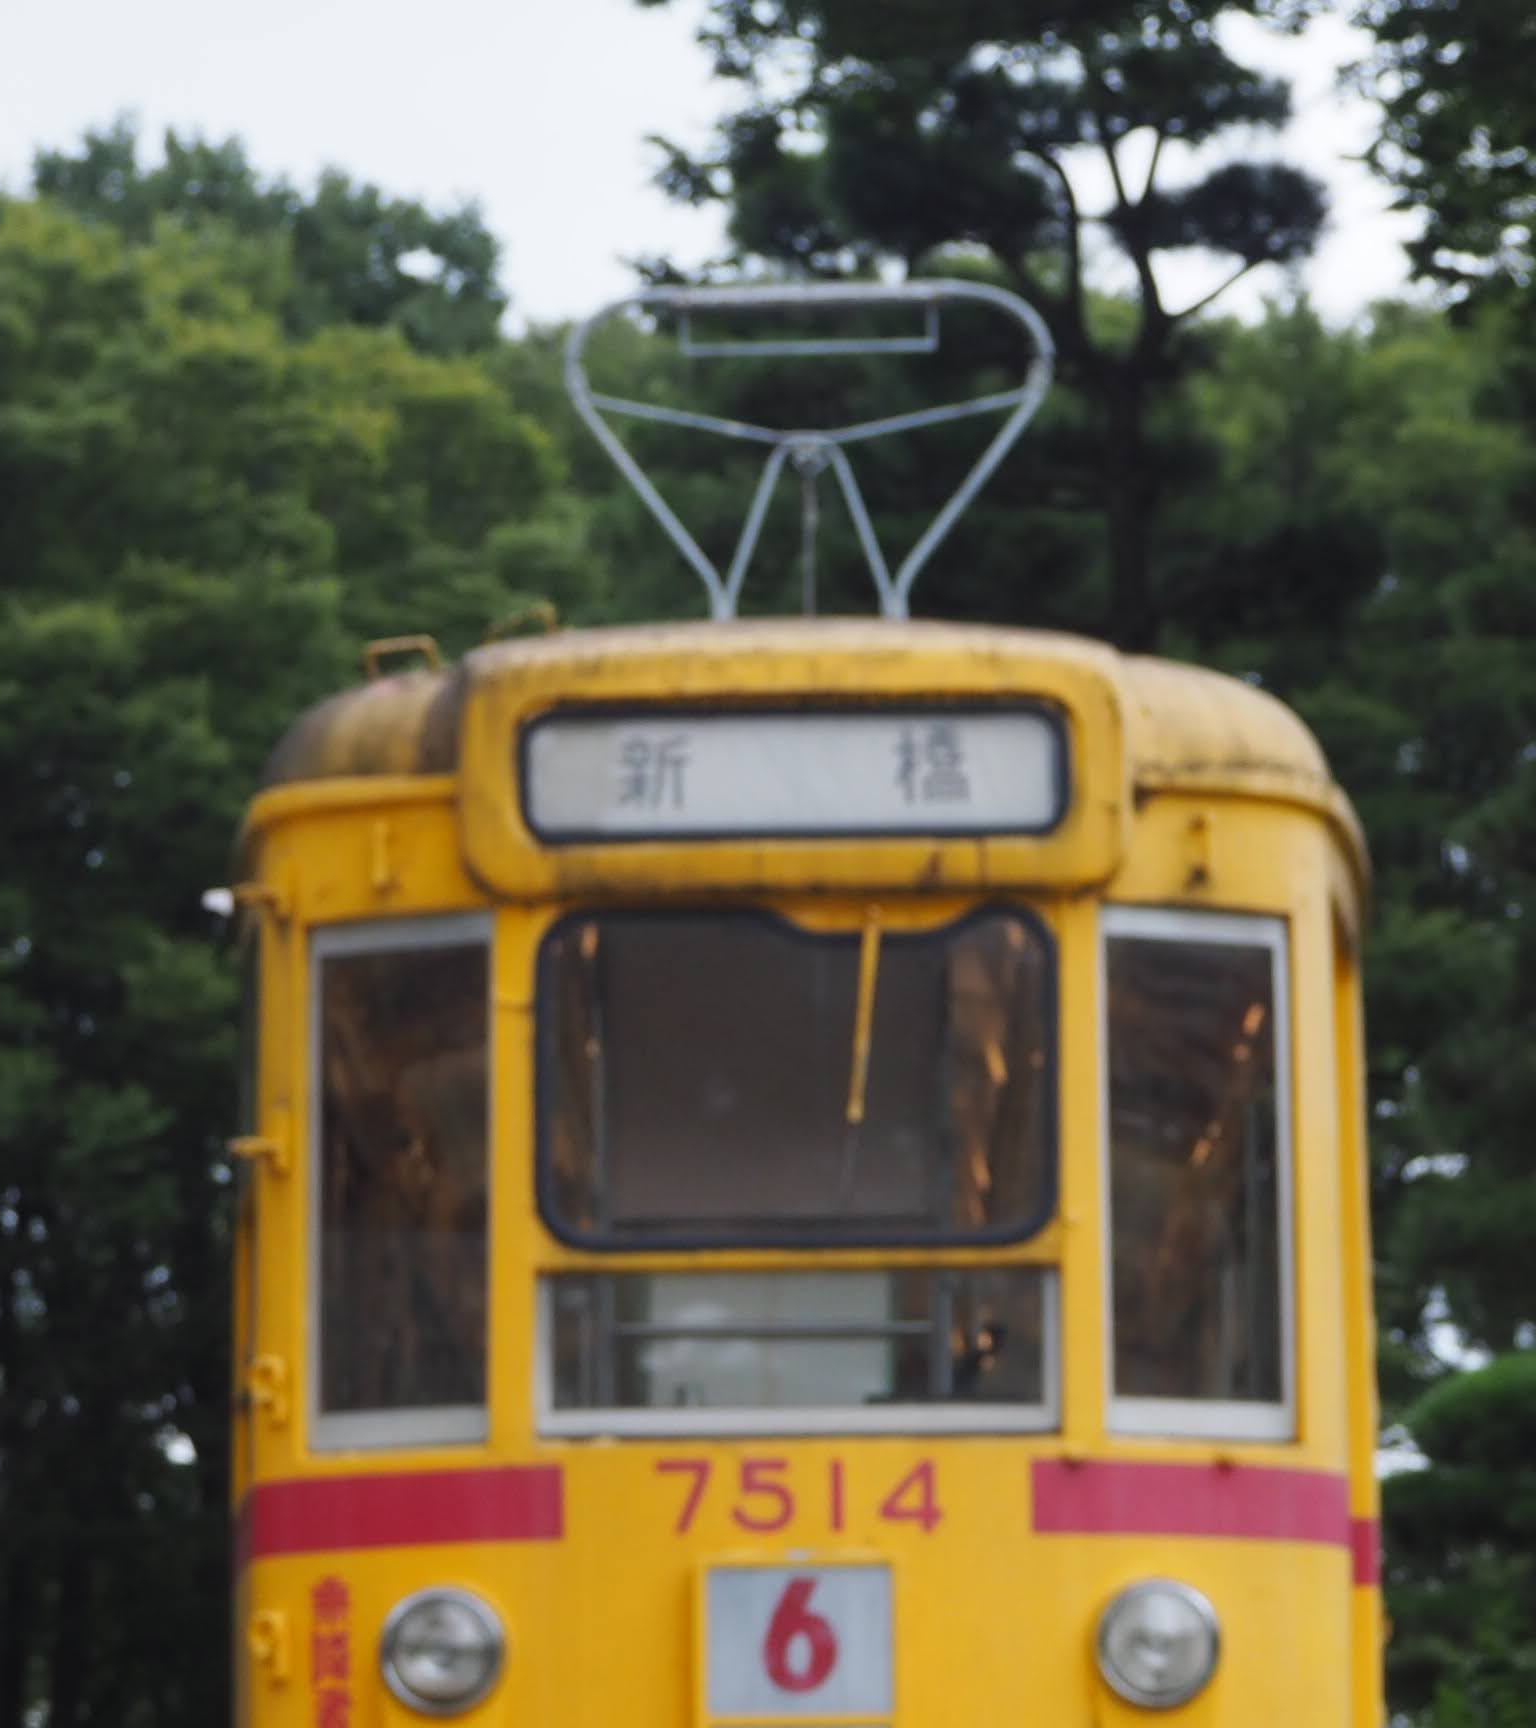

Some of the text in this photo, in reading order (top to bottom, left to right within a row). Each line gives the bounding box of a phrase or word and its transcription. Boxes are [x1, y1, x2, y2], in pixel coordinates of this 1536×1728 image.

[618, 734, 692, 809] 新
[655, 1458, 943, 1535] 7514
[762, 1575, 840, 1695] 6
